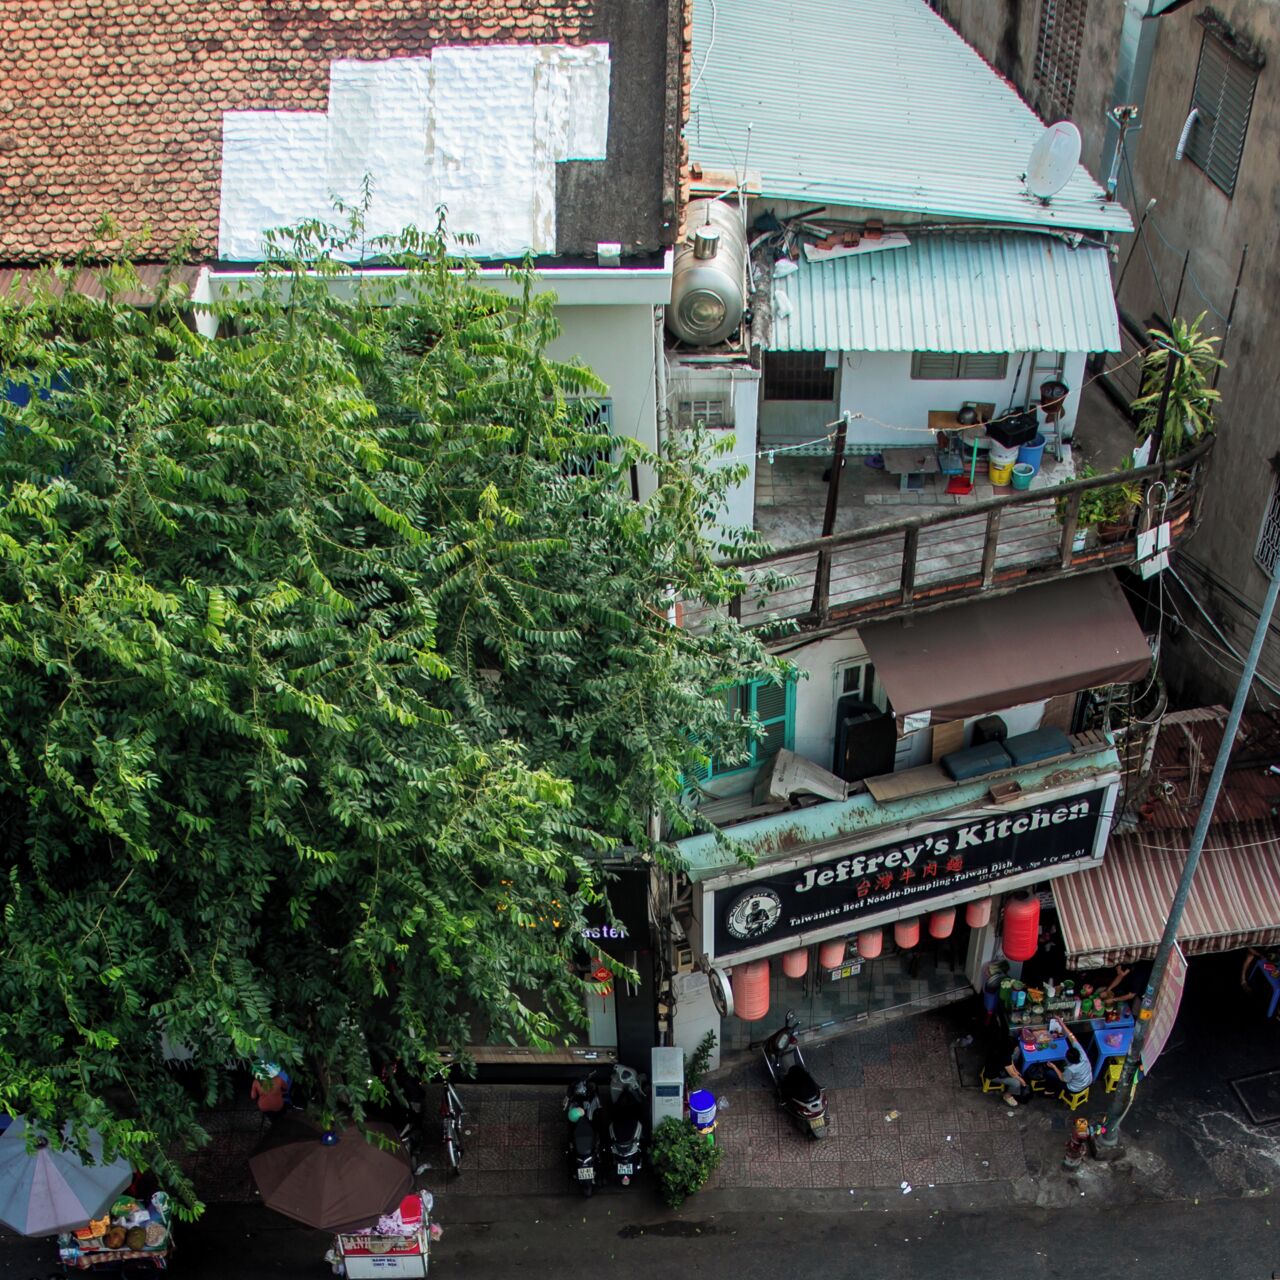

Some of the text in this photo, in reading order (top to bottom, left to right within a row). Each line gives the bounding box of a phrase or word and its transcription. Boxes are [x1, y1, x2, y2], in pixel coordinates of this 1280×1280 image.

[795, 799, 1090, 893] Jeffrey's Kitchen
[789, 906, 840, 927] Taiwanese
[842, 899, 865, 913] Beef
[991, 861, 1013, 872] Dish
